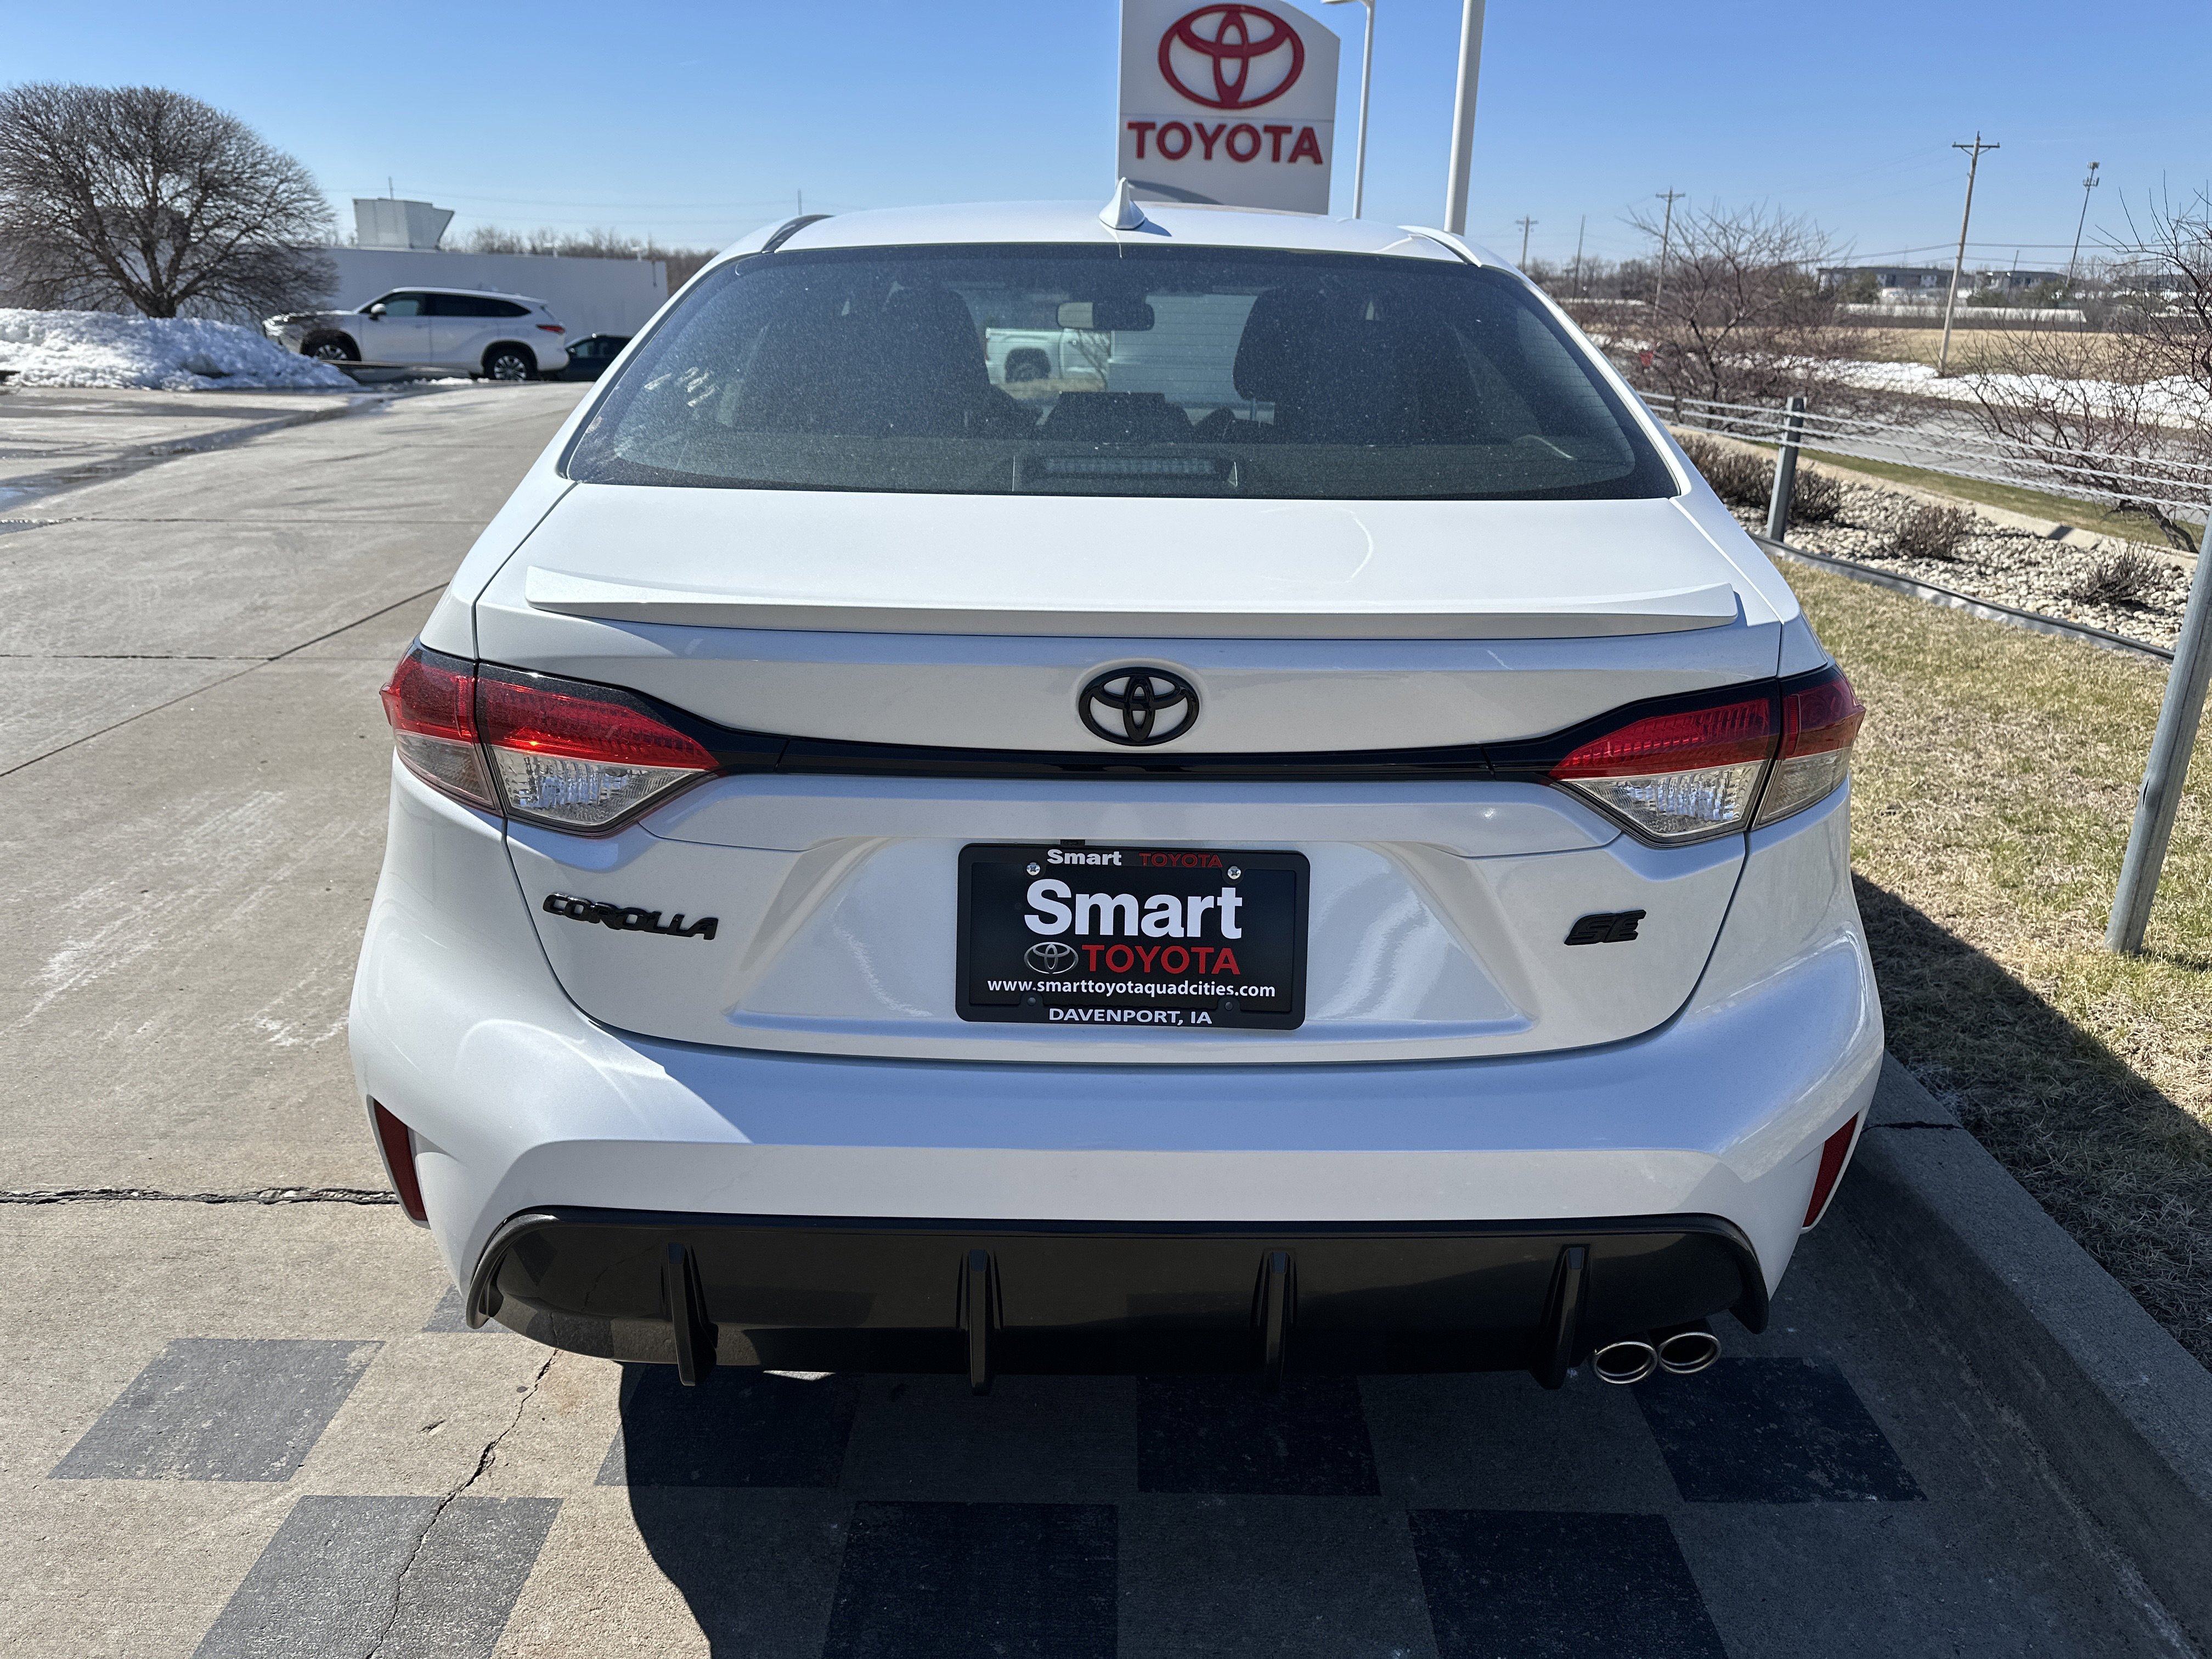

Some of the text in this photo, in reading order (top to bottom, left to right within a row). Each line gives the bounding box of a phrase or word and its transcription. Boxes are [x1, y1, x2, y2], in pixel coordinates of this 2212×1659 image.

[1127, 121, 1323, 165] TOYOTA
[1046, 849, 1223, 868] Smart TOYOTA
[543, 891, 719, 940] COROLLA
[1024, 878, 1242, 939] Smart
[1564, 909, 1647, 946] SE
[1082, 944, 1241, 975] TOYOTA
[988, 978, 1276, 997] www.smarttoyotaquadcities.com
[1049, 1008, 1212, 1026] DAVENPORT, IA
